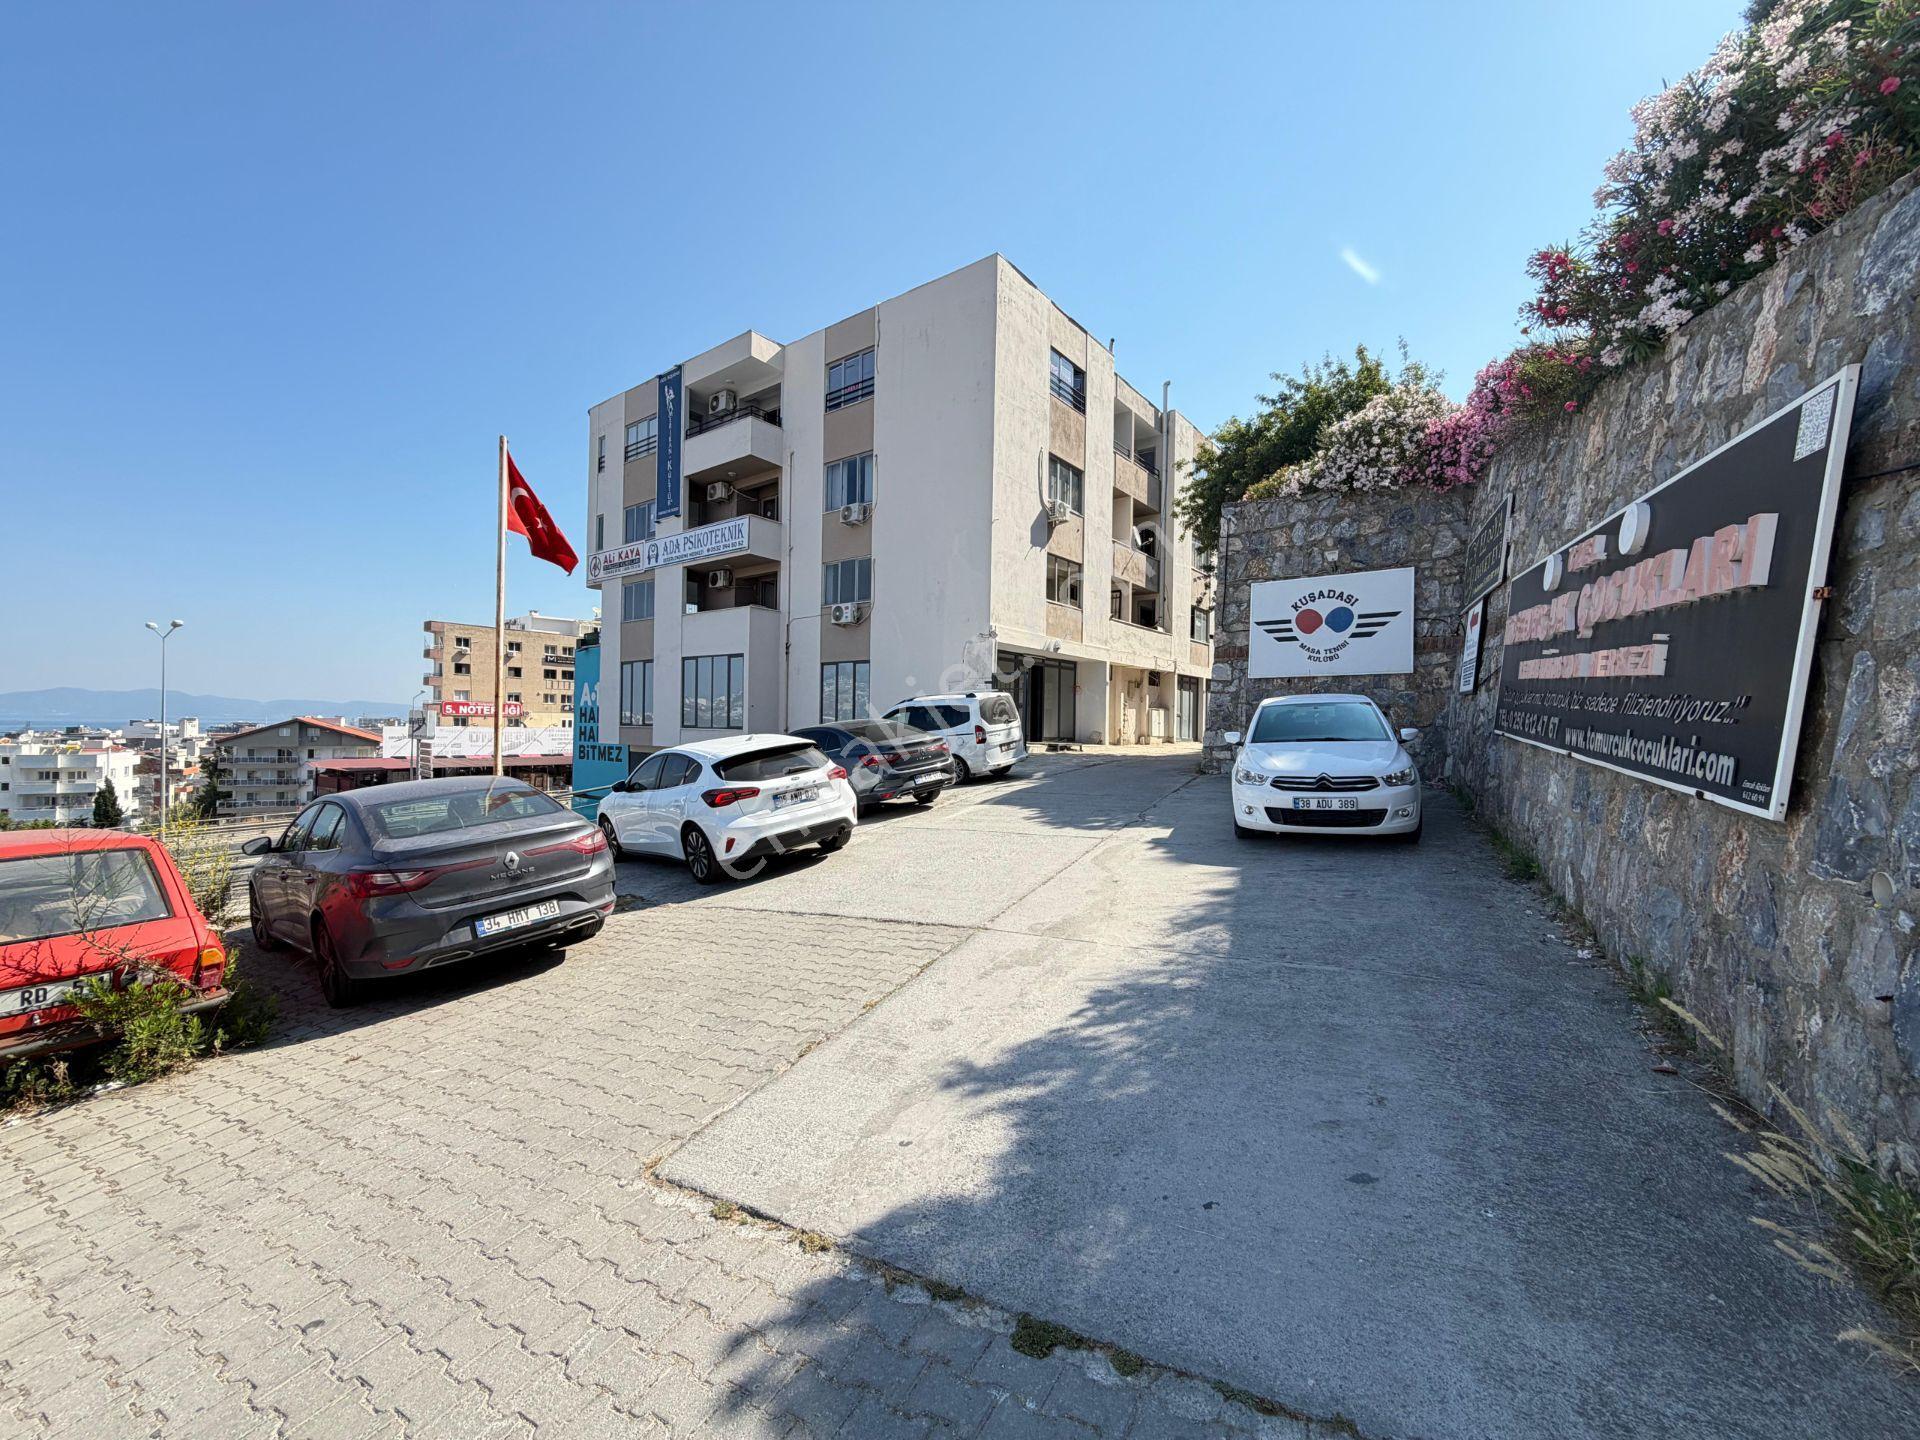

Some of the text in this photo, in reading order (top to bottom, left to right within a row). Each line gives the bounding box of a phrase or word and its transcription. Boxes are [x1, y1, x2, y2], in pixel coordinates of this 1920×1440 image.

[662, 521, 744, 556] ADA PSİKOTEKNİK
[618, 546, 641, 561] KAYA
[1577, 512, 1779, 639] ÇOCUKLARI
[1291, 589, 1360, 612] KUŞADASI
[1299, 640, 1350, 655] MASA TENİSİ
[1307, 653, 1340, 663] KULÜBÜ
[445, 704, 456, 714] 5.
[459, 703, 521, 715] NOTERİĞİ
[1584, 692, 1618, 713] sadece
[1548, 716, 1560, 740] 67
[1565, 725, 1735, 787] www.tomurcukcocuklari.com
[1300, 799, 1355, 809] 38 ADU 389
[489, 866, 536, 880] MEGANE
[484, 917, 500, 931] 34
[536, 901, 557, 917] 138
[20, 988, 48, 1006] RD
